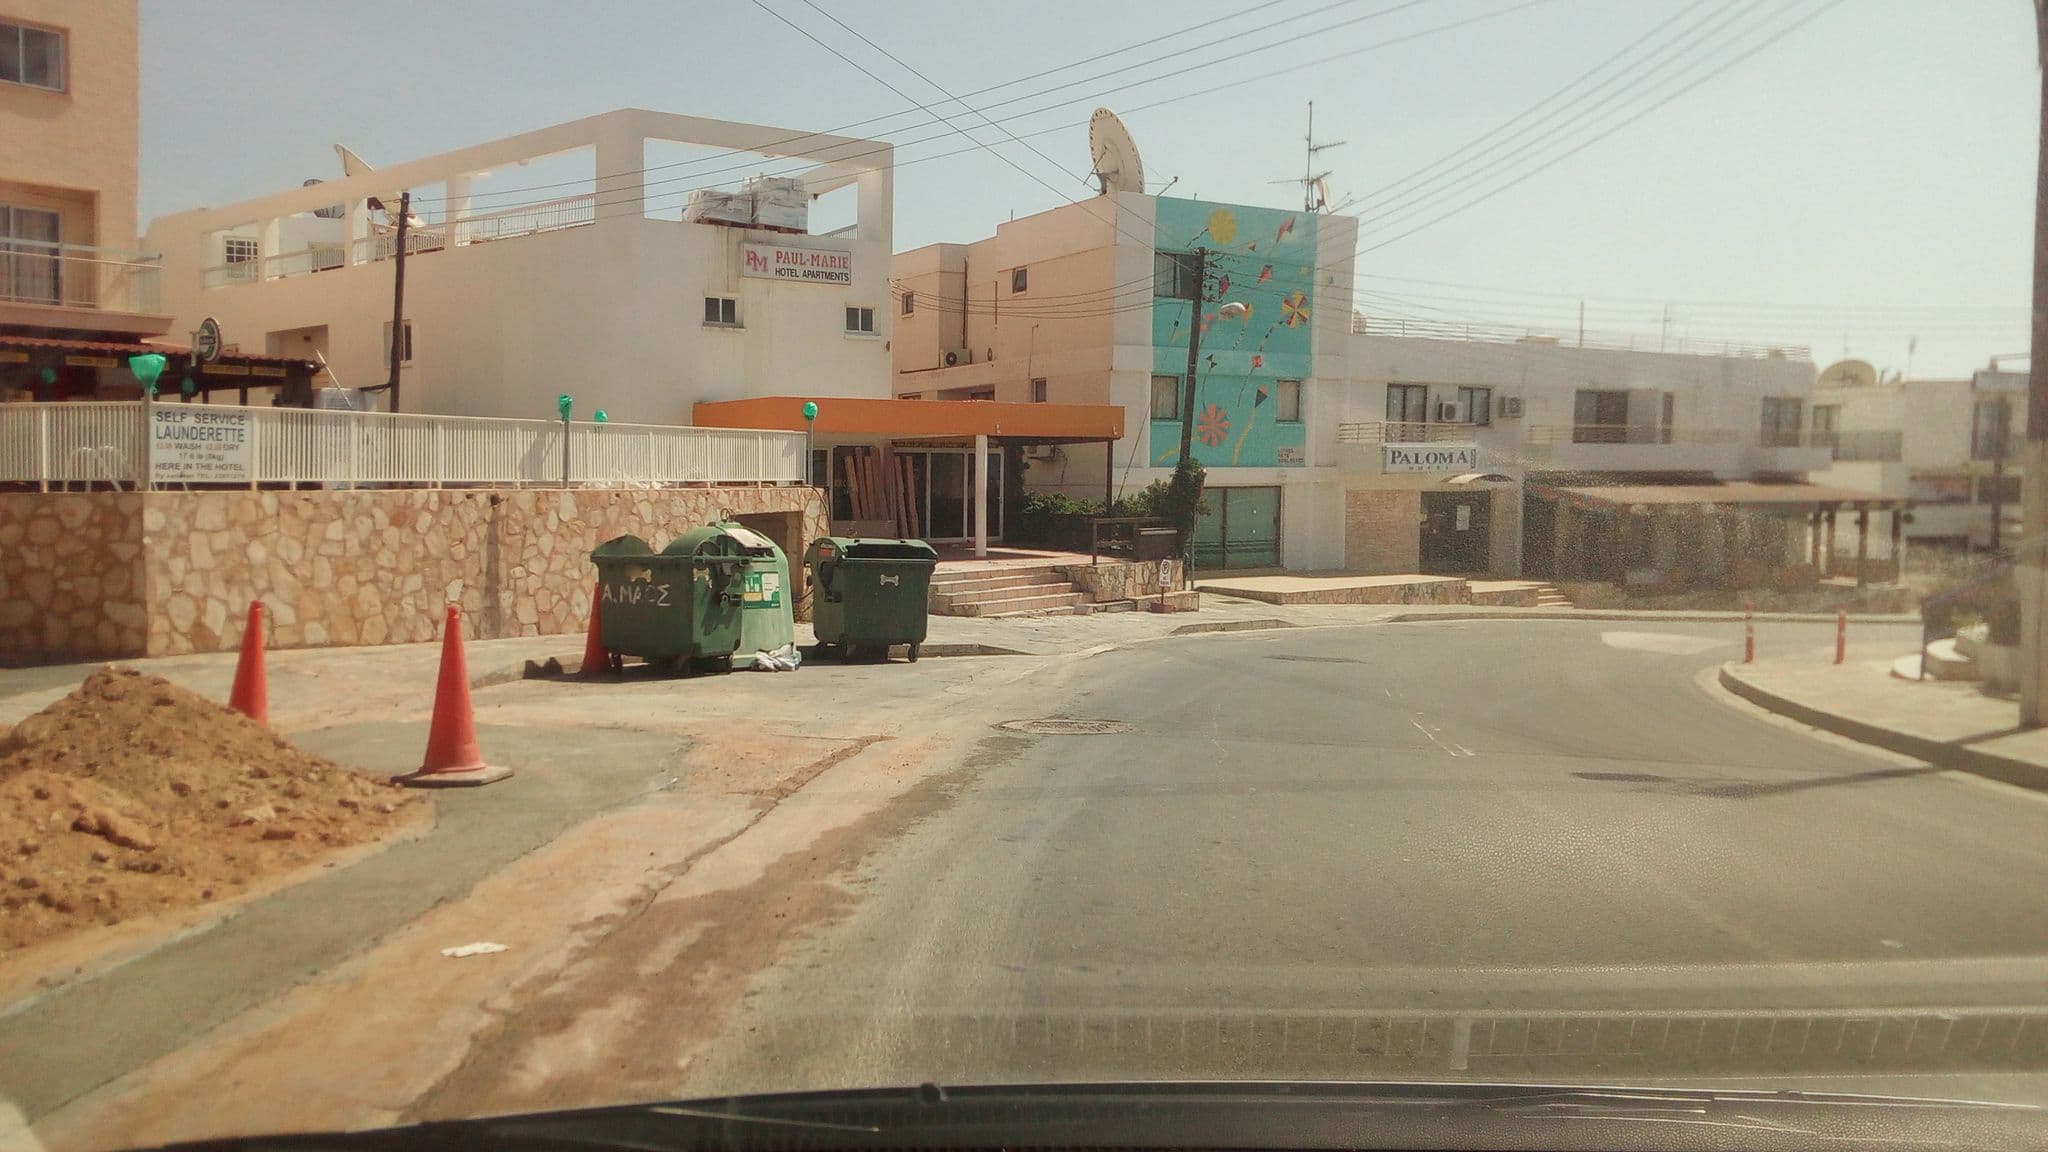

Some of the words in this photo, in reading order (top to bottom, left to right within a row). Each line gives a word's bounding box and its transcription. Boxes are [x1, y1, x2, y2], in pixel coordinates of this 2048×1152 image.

[775, 250, 849, 269] PAUL-MARIE
[775, 267, 799, 278] HOTEL
[802, 270, 850, 281] APARTMENTS
[156, 411, 187, 423] SELF
[194, 412, 245, 426] SERVICE
[156, 425, 245, 442] LAUNDERETTE
[175, 442, 202, 450] WASH
[1390, 449, 1469, 465] PALOMA
[155, 462, 181, 471] HERE
[195, 462, 213, 471] THE
[215, 463, 245, 471] HOTEL
